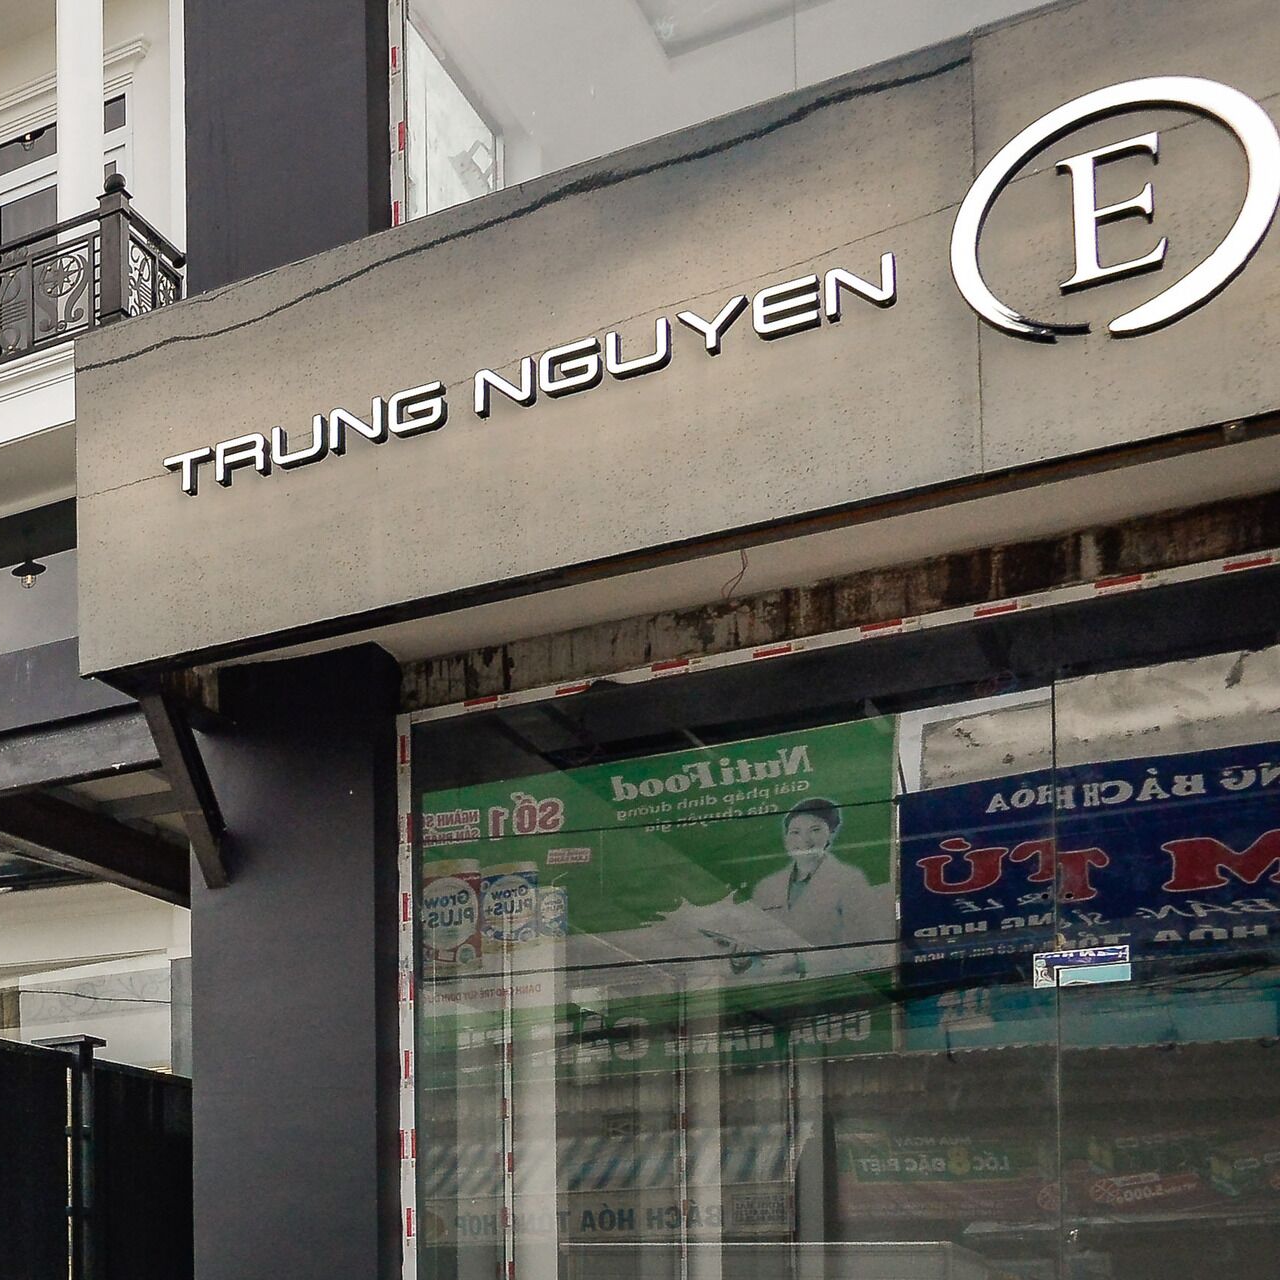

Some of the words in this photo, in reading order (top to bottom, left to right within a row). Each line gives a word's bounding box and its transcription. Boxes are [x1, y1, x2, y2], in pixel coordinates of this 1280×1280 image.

[1055, 131, 1168, 297] E
[163, 379, 449, 497] TRUNG
[473, 251, 898, 419] NGUYEN
